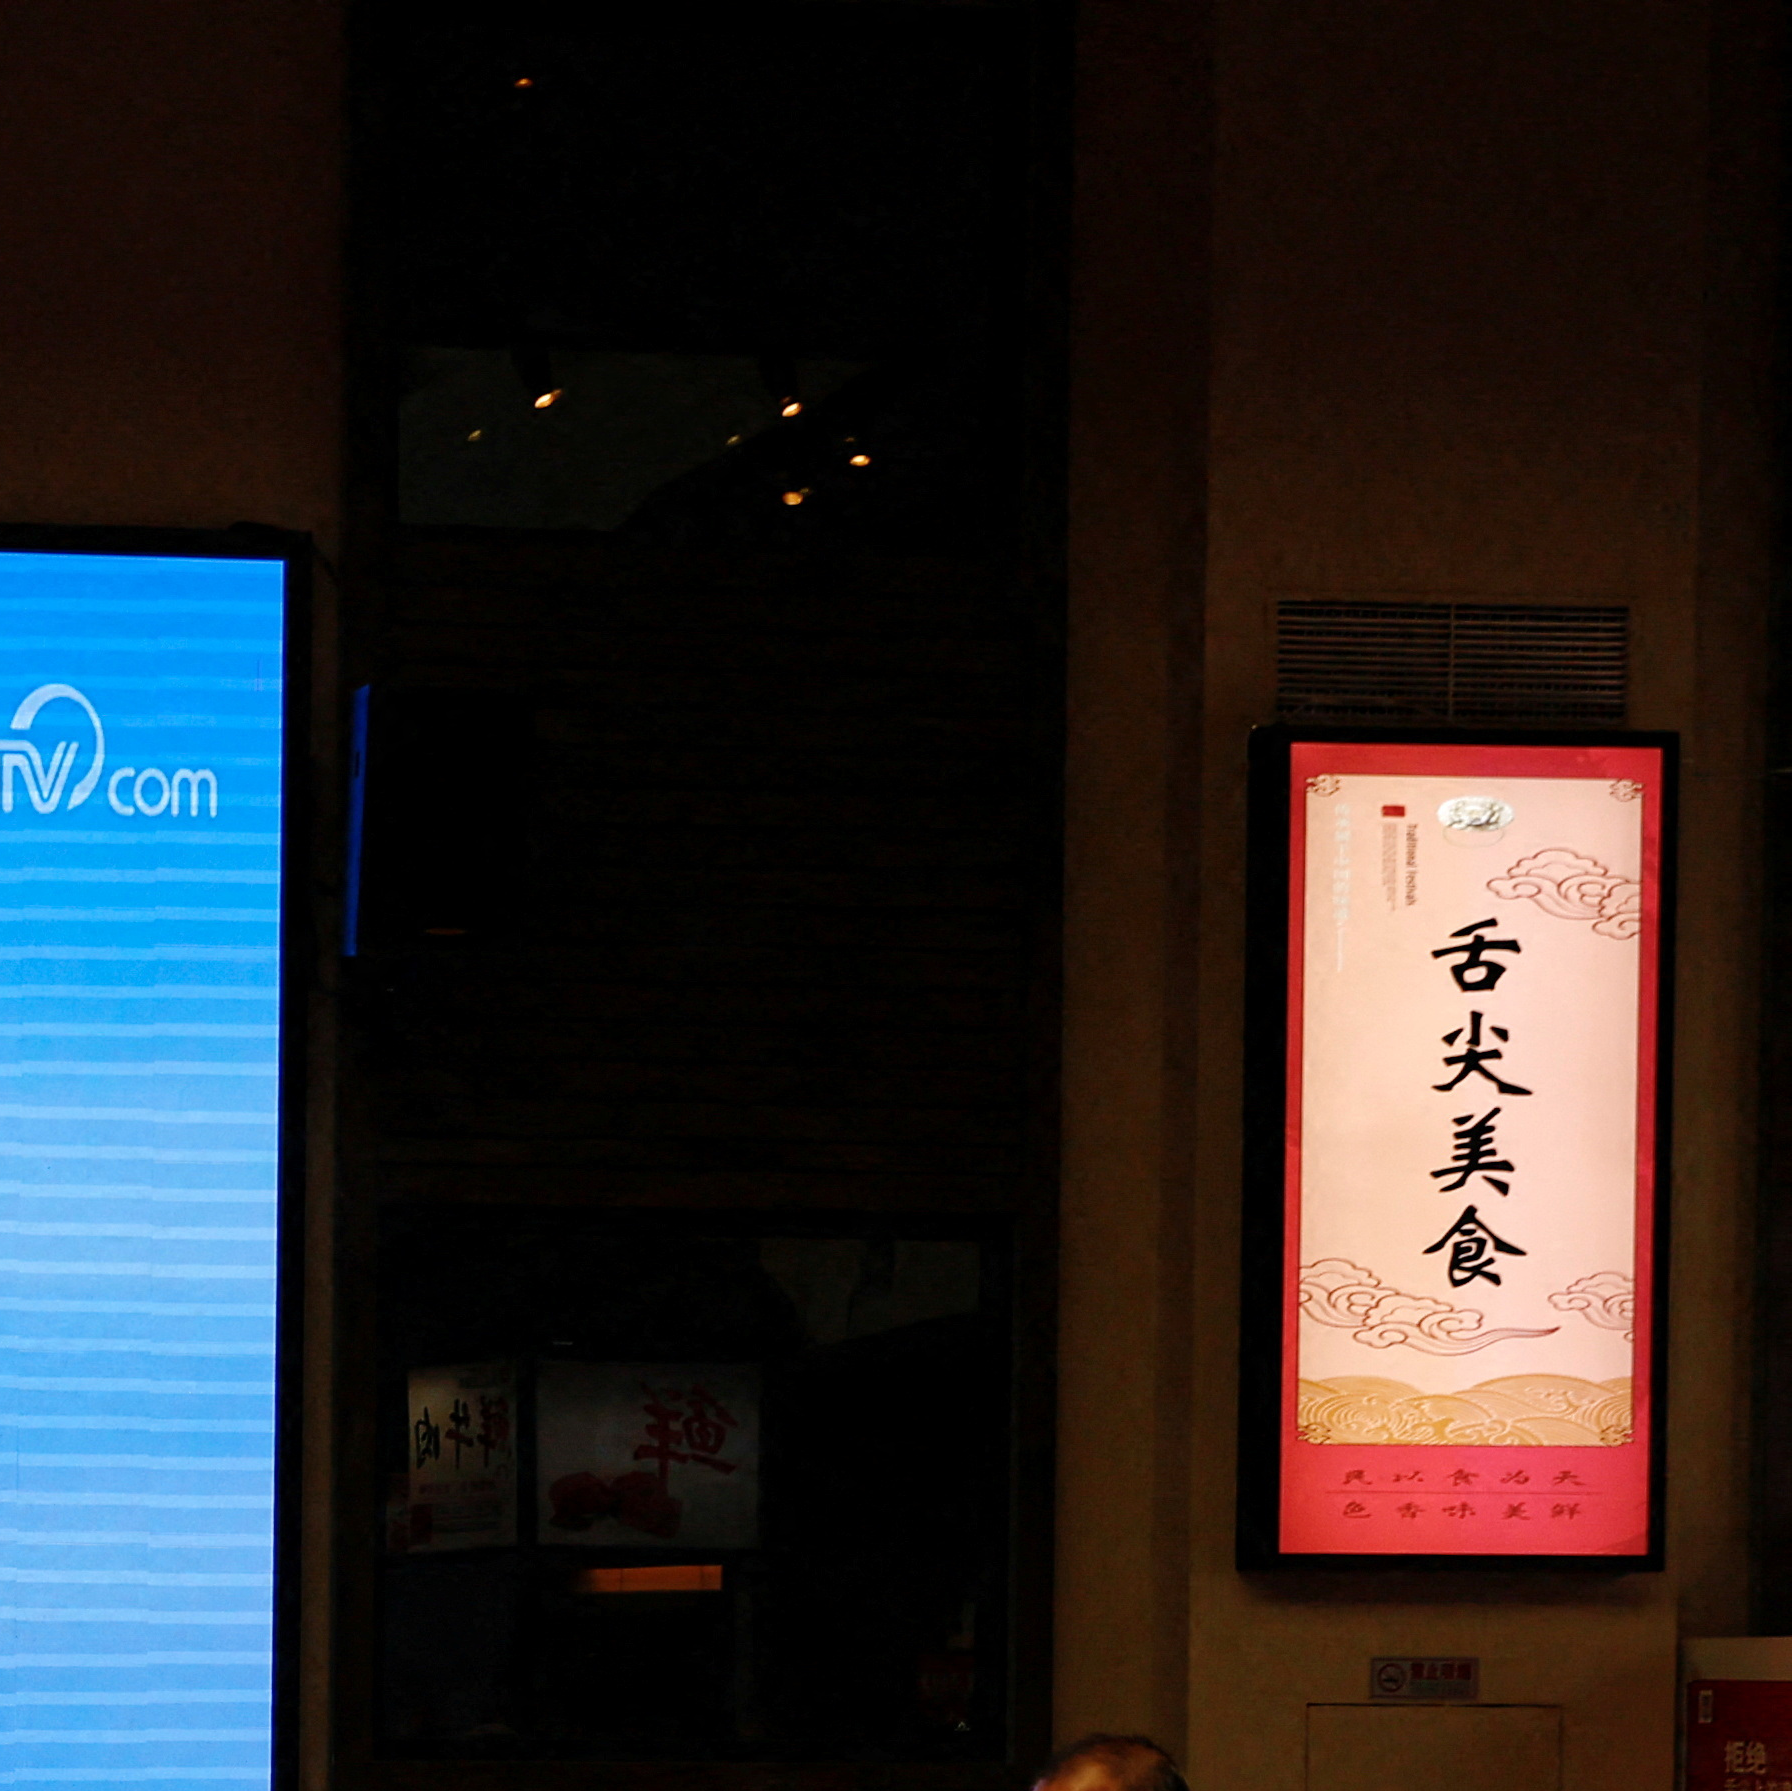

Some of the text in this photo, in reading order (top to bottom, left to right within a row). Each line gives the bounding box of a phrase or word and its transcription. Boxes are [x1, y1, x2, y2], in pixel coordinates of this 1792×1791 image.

[108, 767, 217, 818] com
[1423, 917, 1533, 1288] 舌尖美食
[1342, 1468, 1587, 1487] 民以食为天
[1343, 1501, 1583, 1521] 色香味美鲜
[1723, 1739, 1768, 1776] 拒绝
